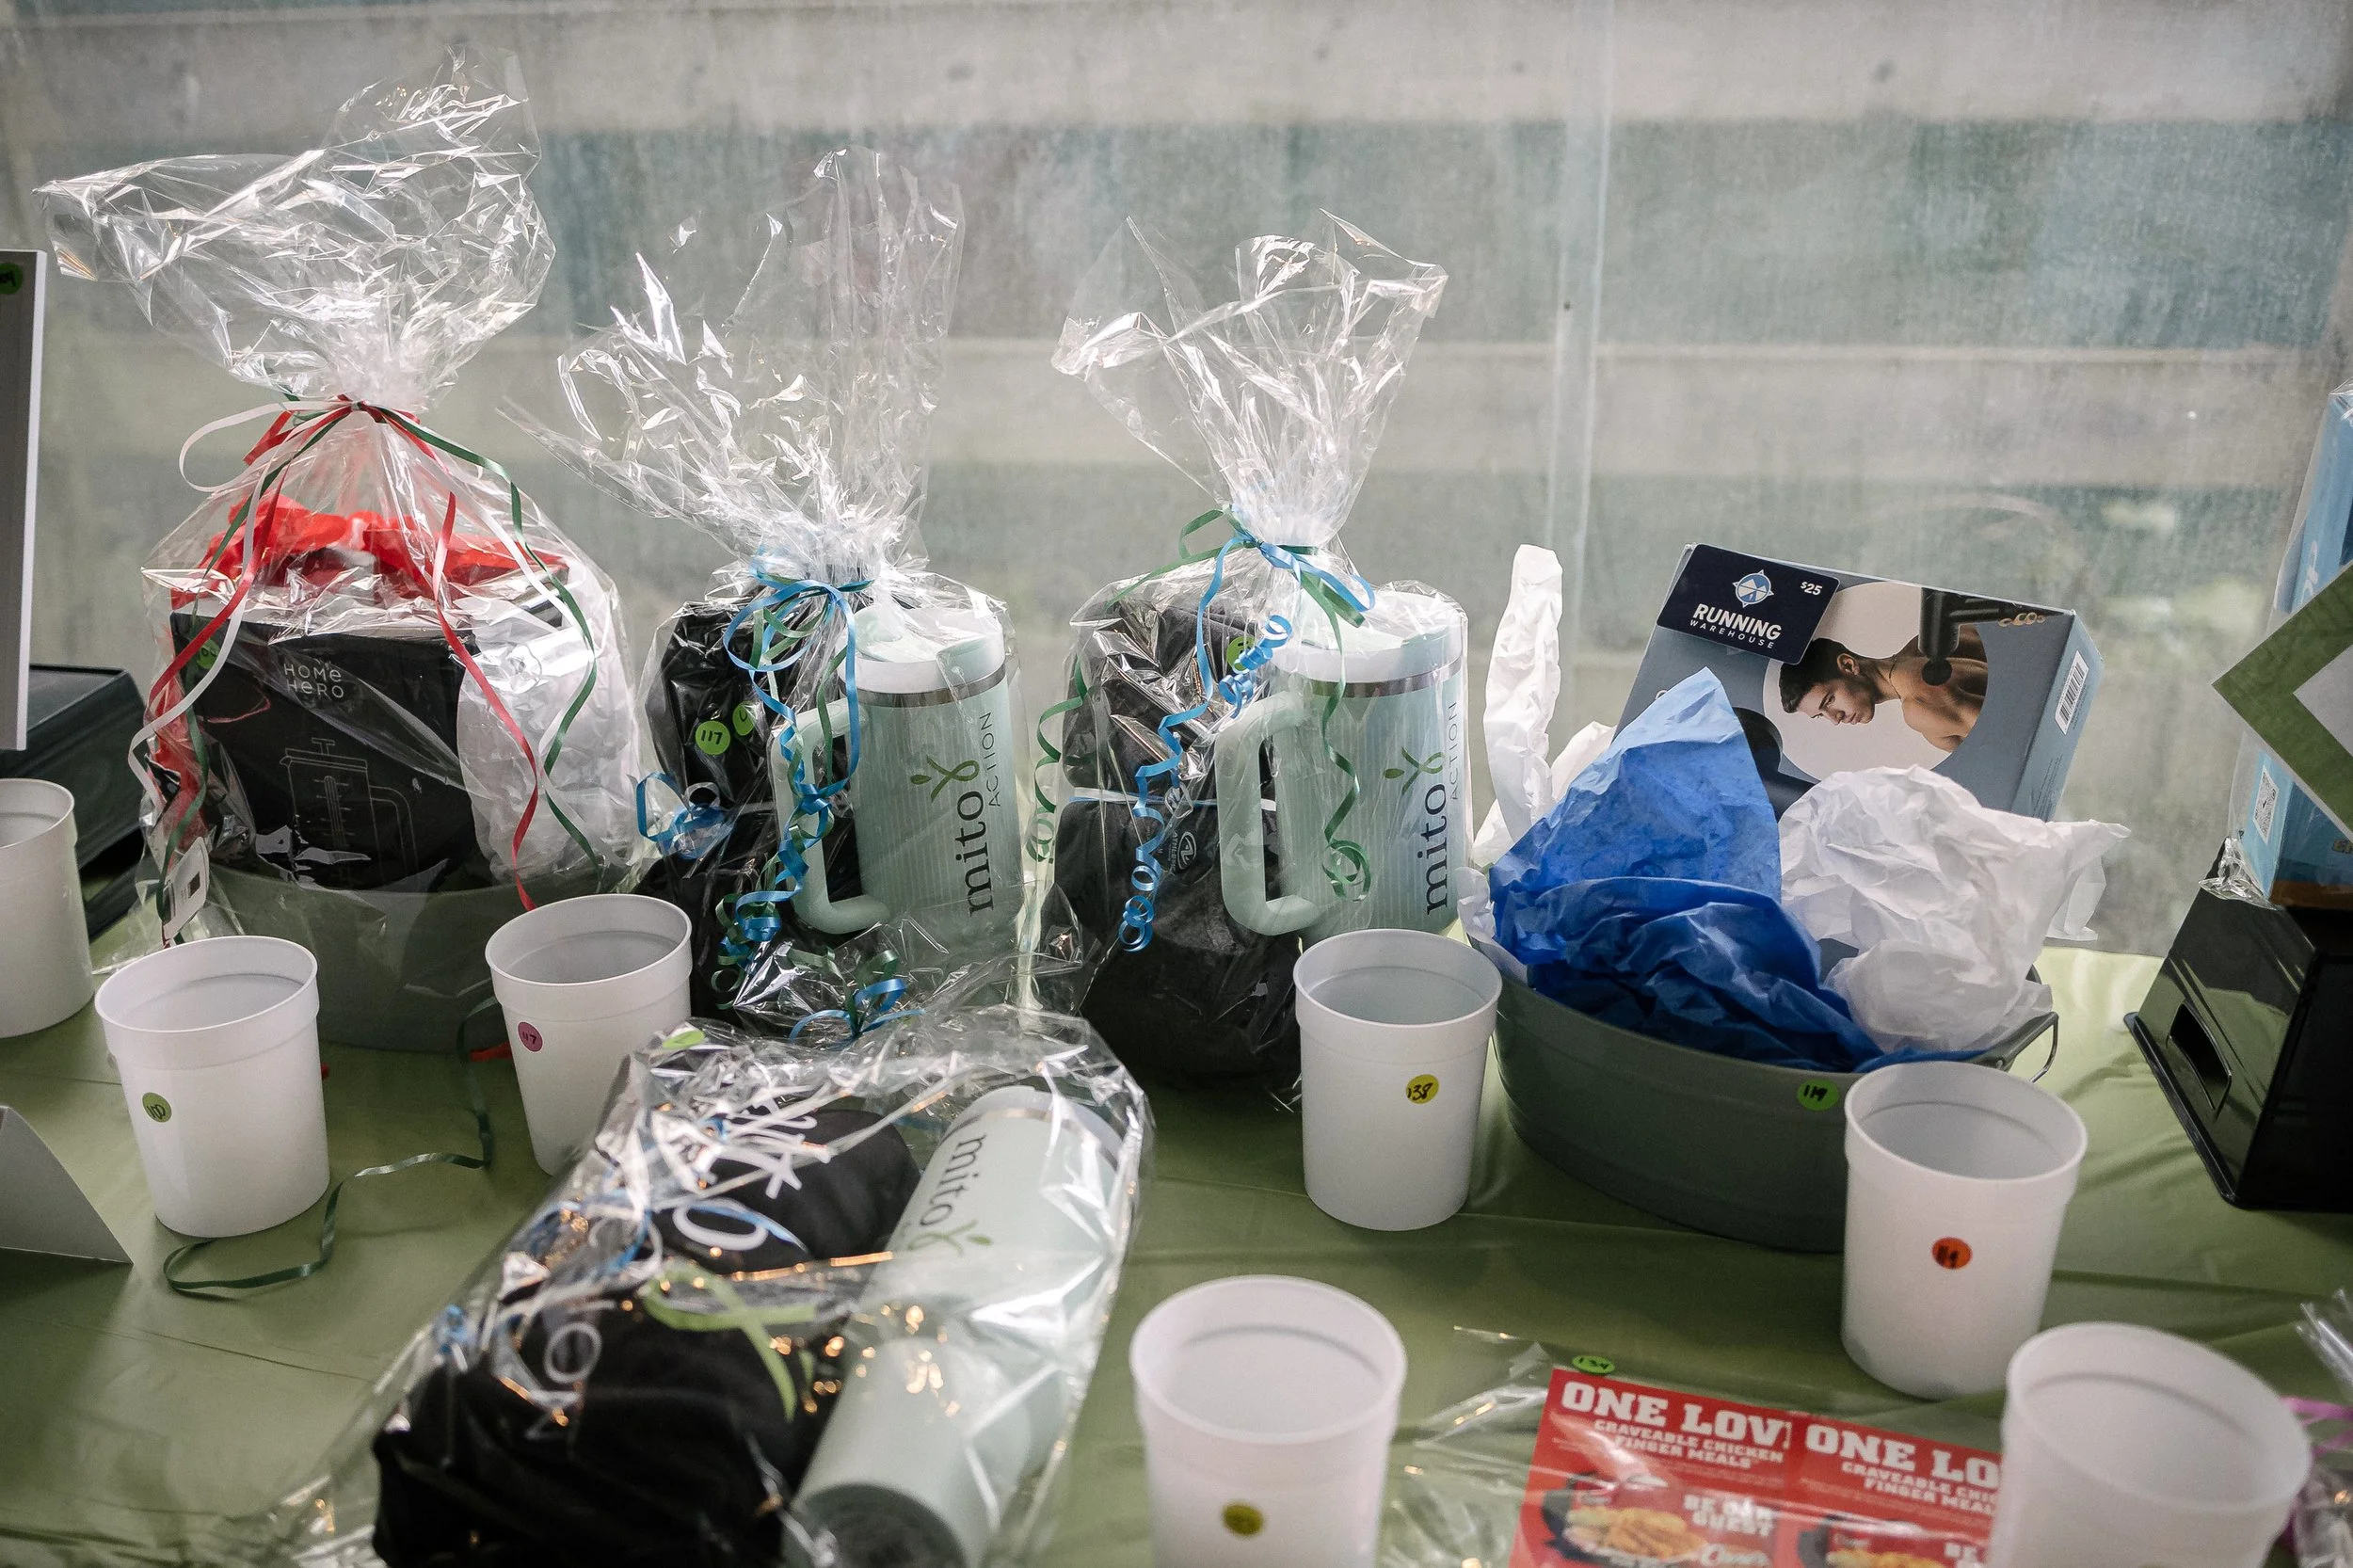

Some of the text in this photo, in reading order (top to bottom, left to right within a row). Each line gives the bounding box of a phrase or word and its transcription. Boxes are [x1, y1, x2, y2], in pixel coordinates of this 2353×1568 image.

[1800, 581, 1823, 596] $25
[1689, 619, 1774, 649] WAREHOUSE
[1692, 603, 1782, 641] RUNNING
[700, 728, 723, 745] 117
[1448, 701, 1459, 800] ACTION
[979, 712, 1001, 808] ACTION
[954, 790, 995, 918] mito
[1417, 783, 1448, 916] mito
[521, 1031, 537, 1045] 117
[1407, 1082, 1433, 1101] 138
[920, 1133, 987, 1226] mito
[1561, 1381, 1669, 1428] ONE
[1614, 1435, 1752, 1470] FINGER MEALS
[1703, 1438, 1785, 1464] CHICKEN
[1806, 1424, 1916, 1473] ONE
[1863, 1476, 1935, 1504] FINGER
